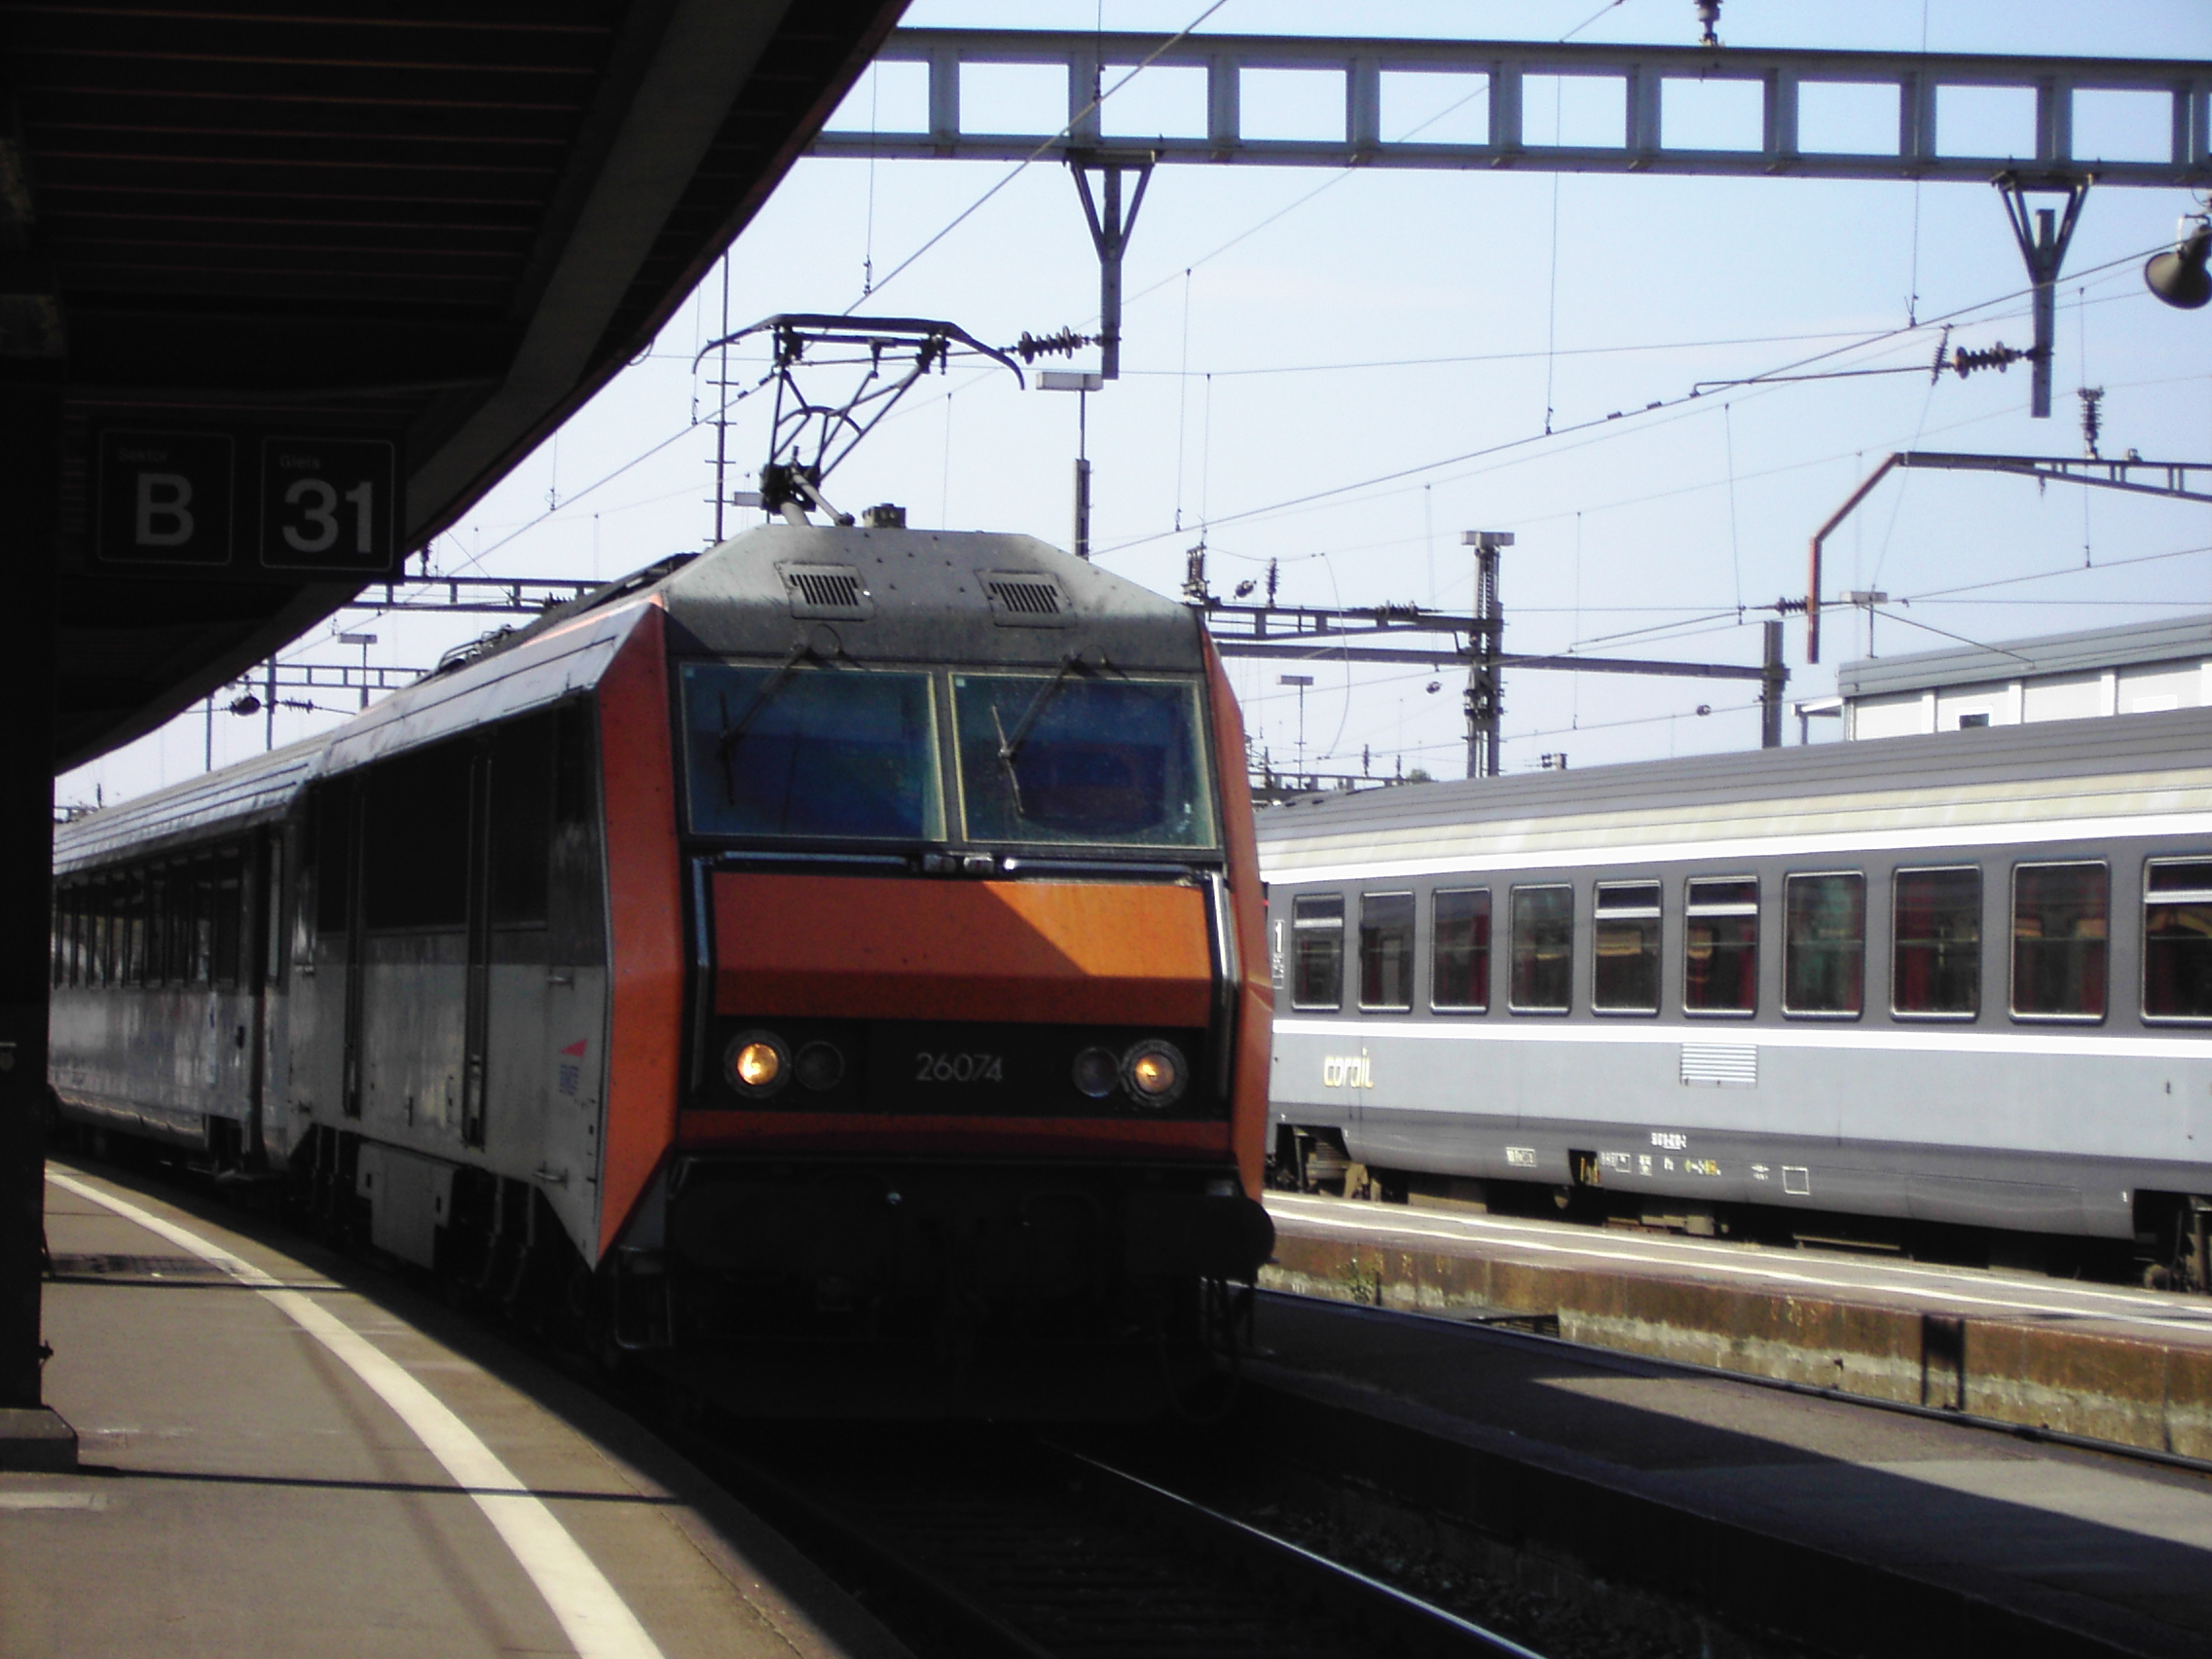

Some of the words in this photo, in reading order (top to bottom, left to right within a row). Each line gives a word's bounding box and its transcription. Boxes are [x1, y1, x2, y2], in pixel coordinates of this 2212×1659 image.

[280, 455, 321, 469] Gleis
[135, 472, 195, 547] B
[281, 477, 373, 554] 31
[915, 1051, 1004, 1083] 26074
